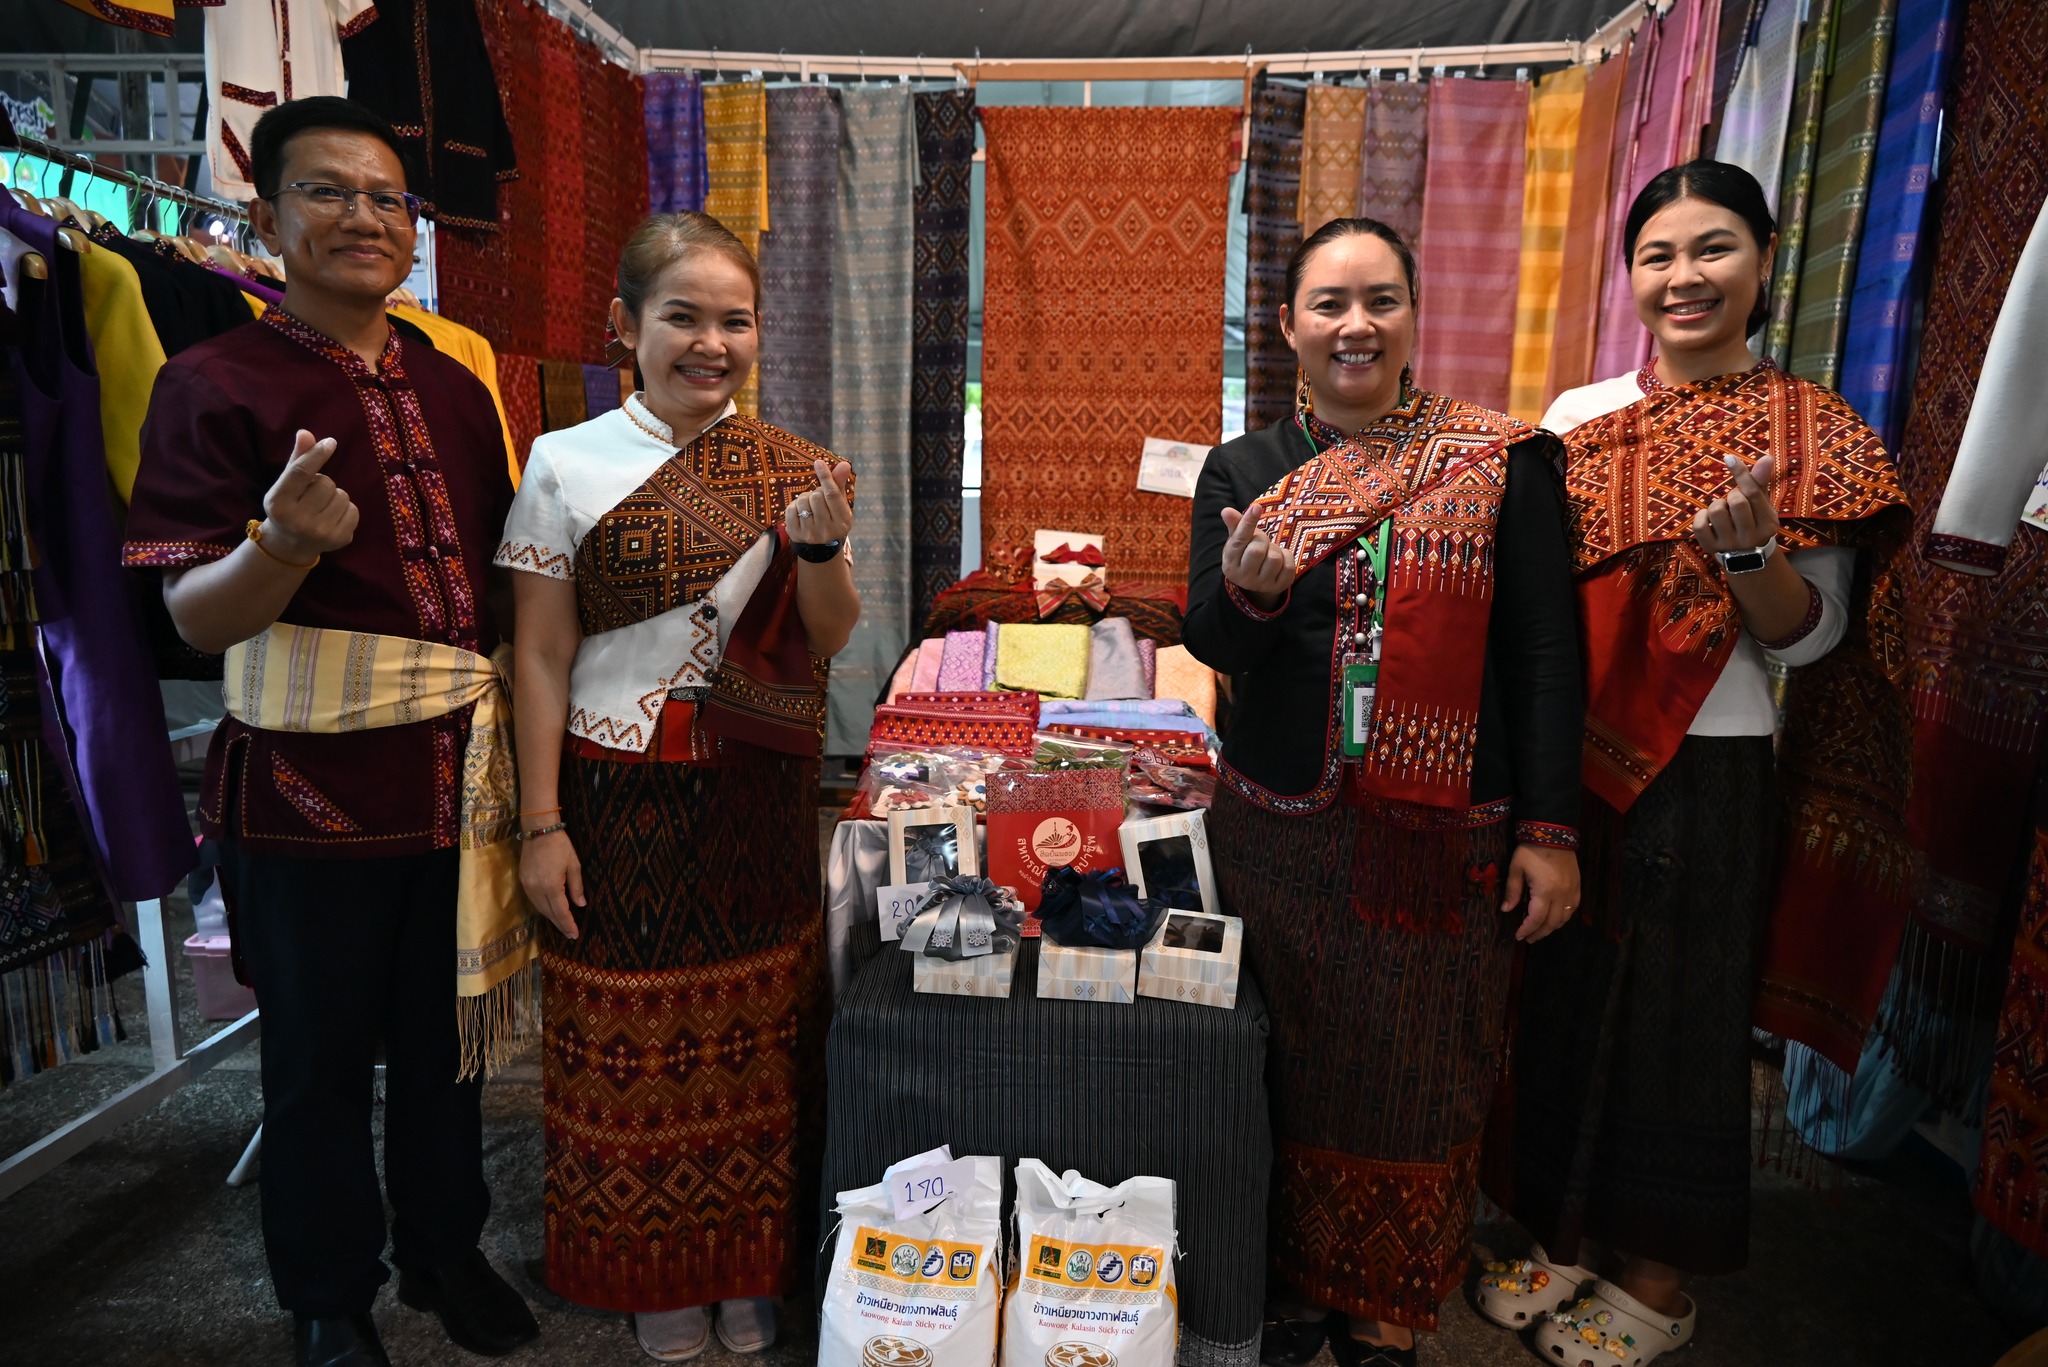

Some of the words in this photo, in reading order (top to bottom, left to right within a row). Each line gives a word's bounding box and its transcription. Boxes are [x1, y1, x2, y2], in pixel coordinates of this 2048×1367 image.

[860, 1309, 890, 1324] Kaowong
[892, 1317, 913, 1327] Kalasin
[915, 1320, 937, 1331] Sticky
[939, 1323, 953, 1331] rice
[1038, 1318, 1069, 1331] Kaowong
[1071, 1323, 1096, 1333] Kalasin
[1098, 1325, 1120, 1336] Sticky
[1121, 1327, 1135, 1335] rice
